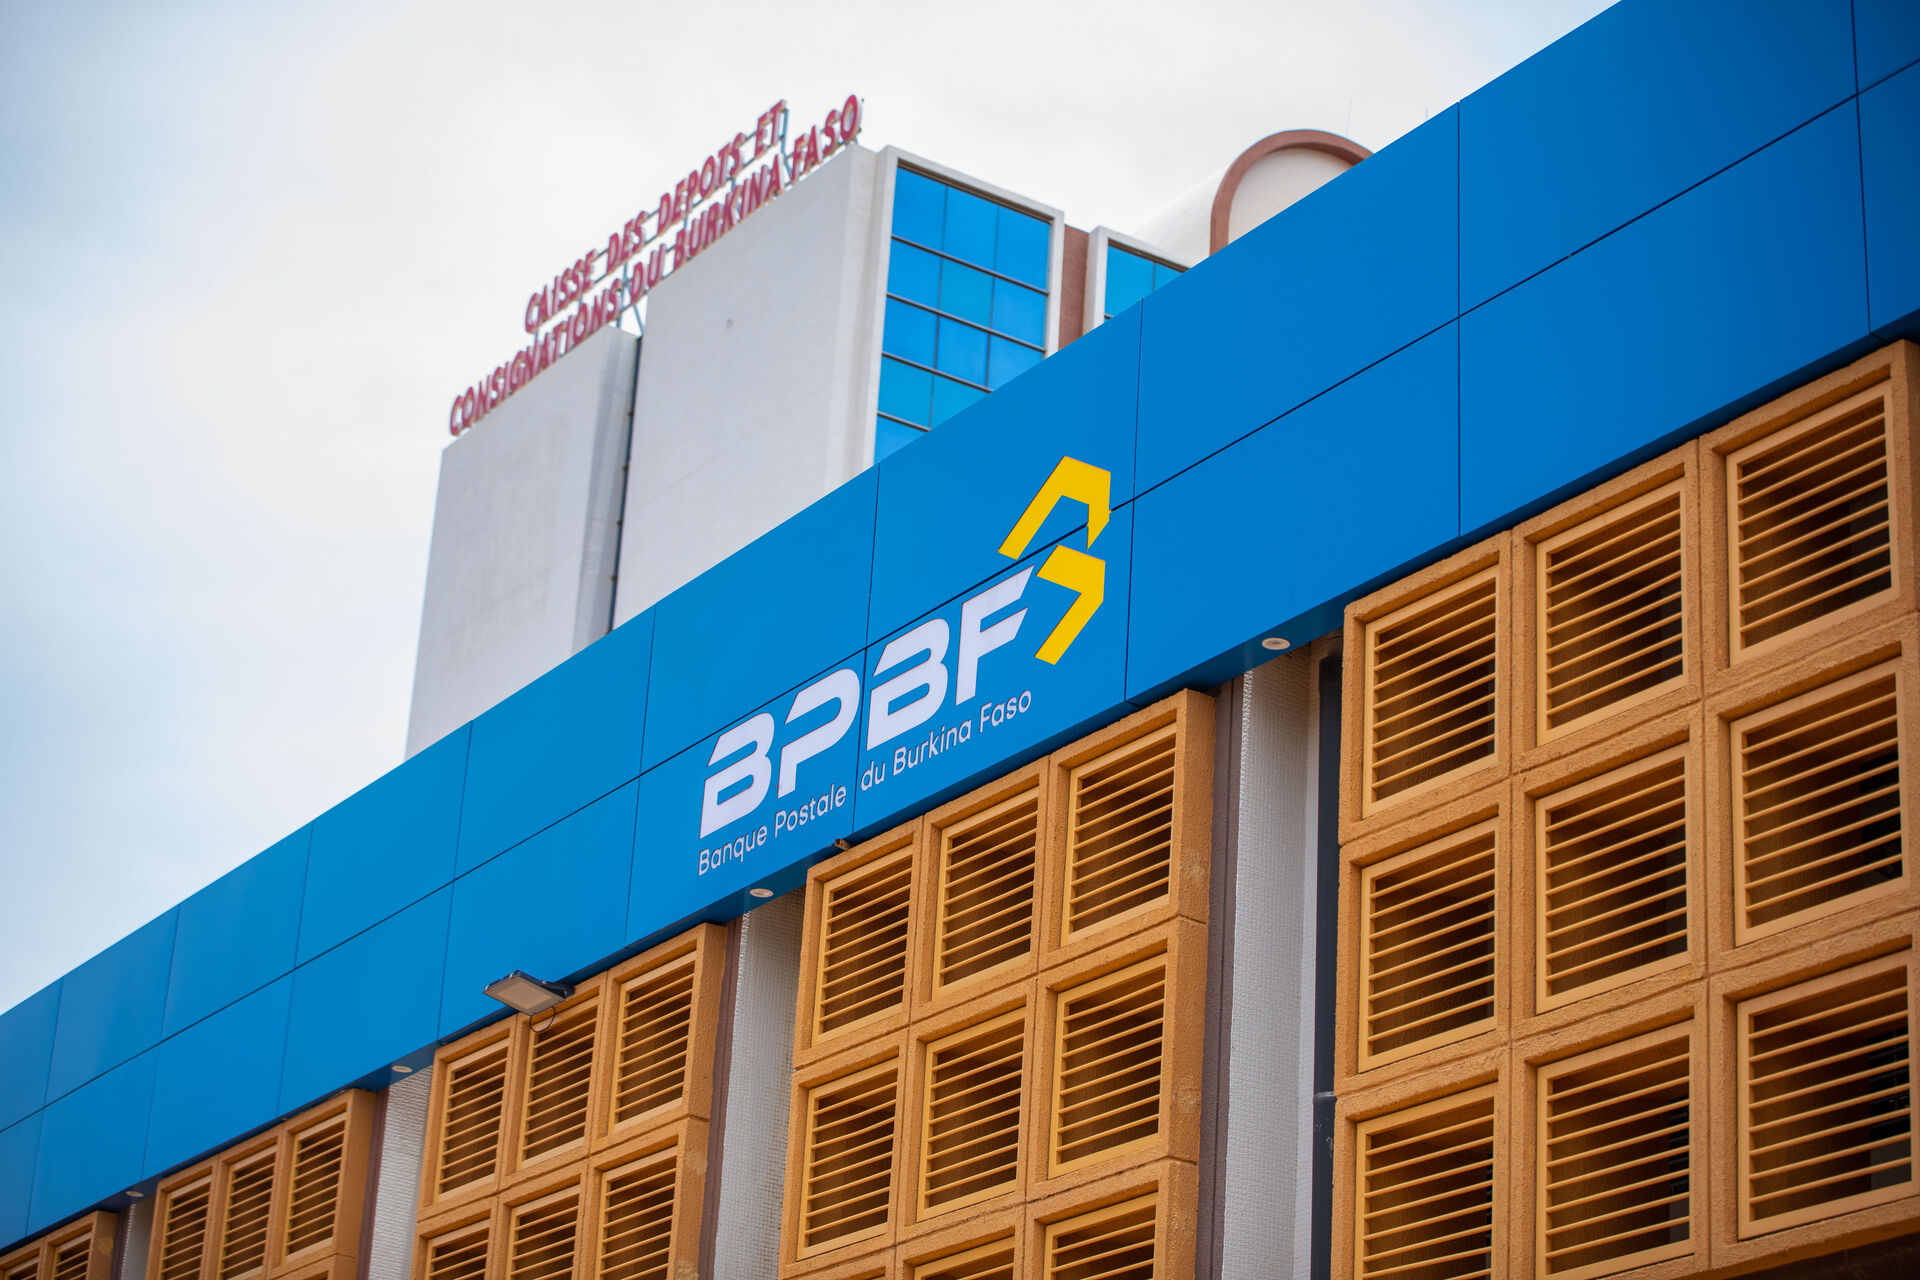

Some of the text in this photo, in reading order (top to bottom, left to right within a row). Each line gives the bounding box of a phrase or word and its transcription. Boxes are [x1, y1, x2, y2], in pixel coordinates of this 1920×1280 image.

[450, 94, 862, 435] CONSIGNATIONS DU BURKINA FASO
[525, 99, 786, 333] CAISSE DES DEPOTS ET
[698, 690, 1031, 876] Banque Postale du Burkina Faso
[700, 564, 1035, 839] BPBF
